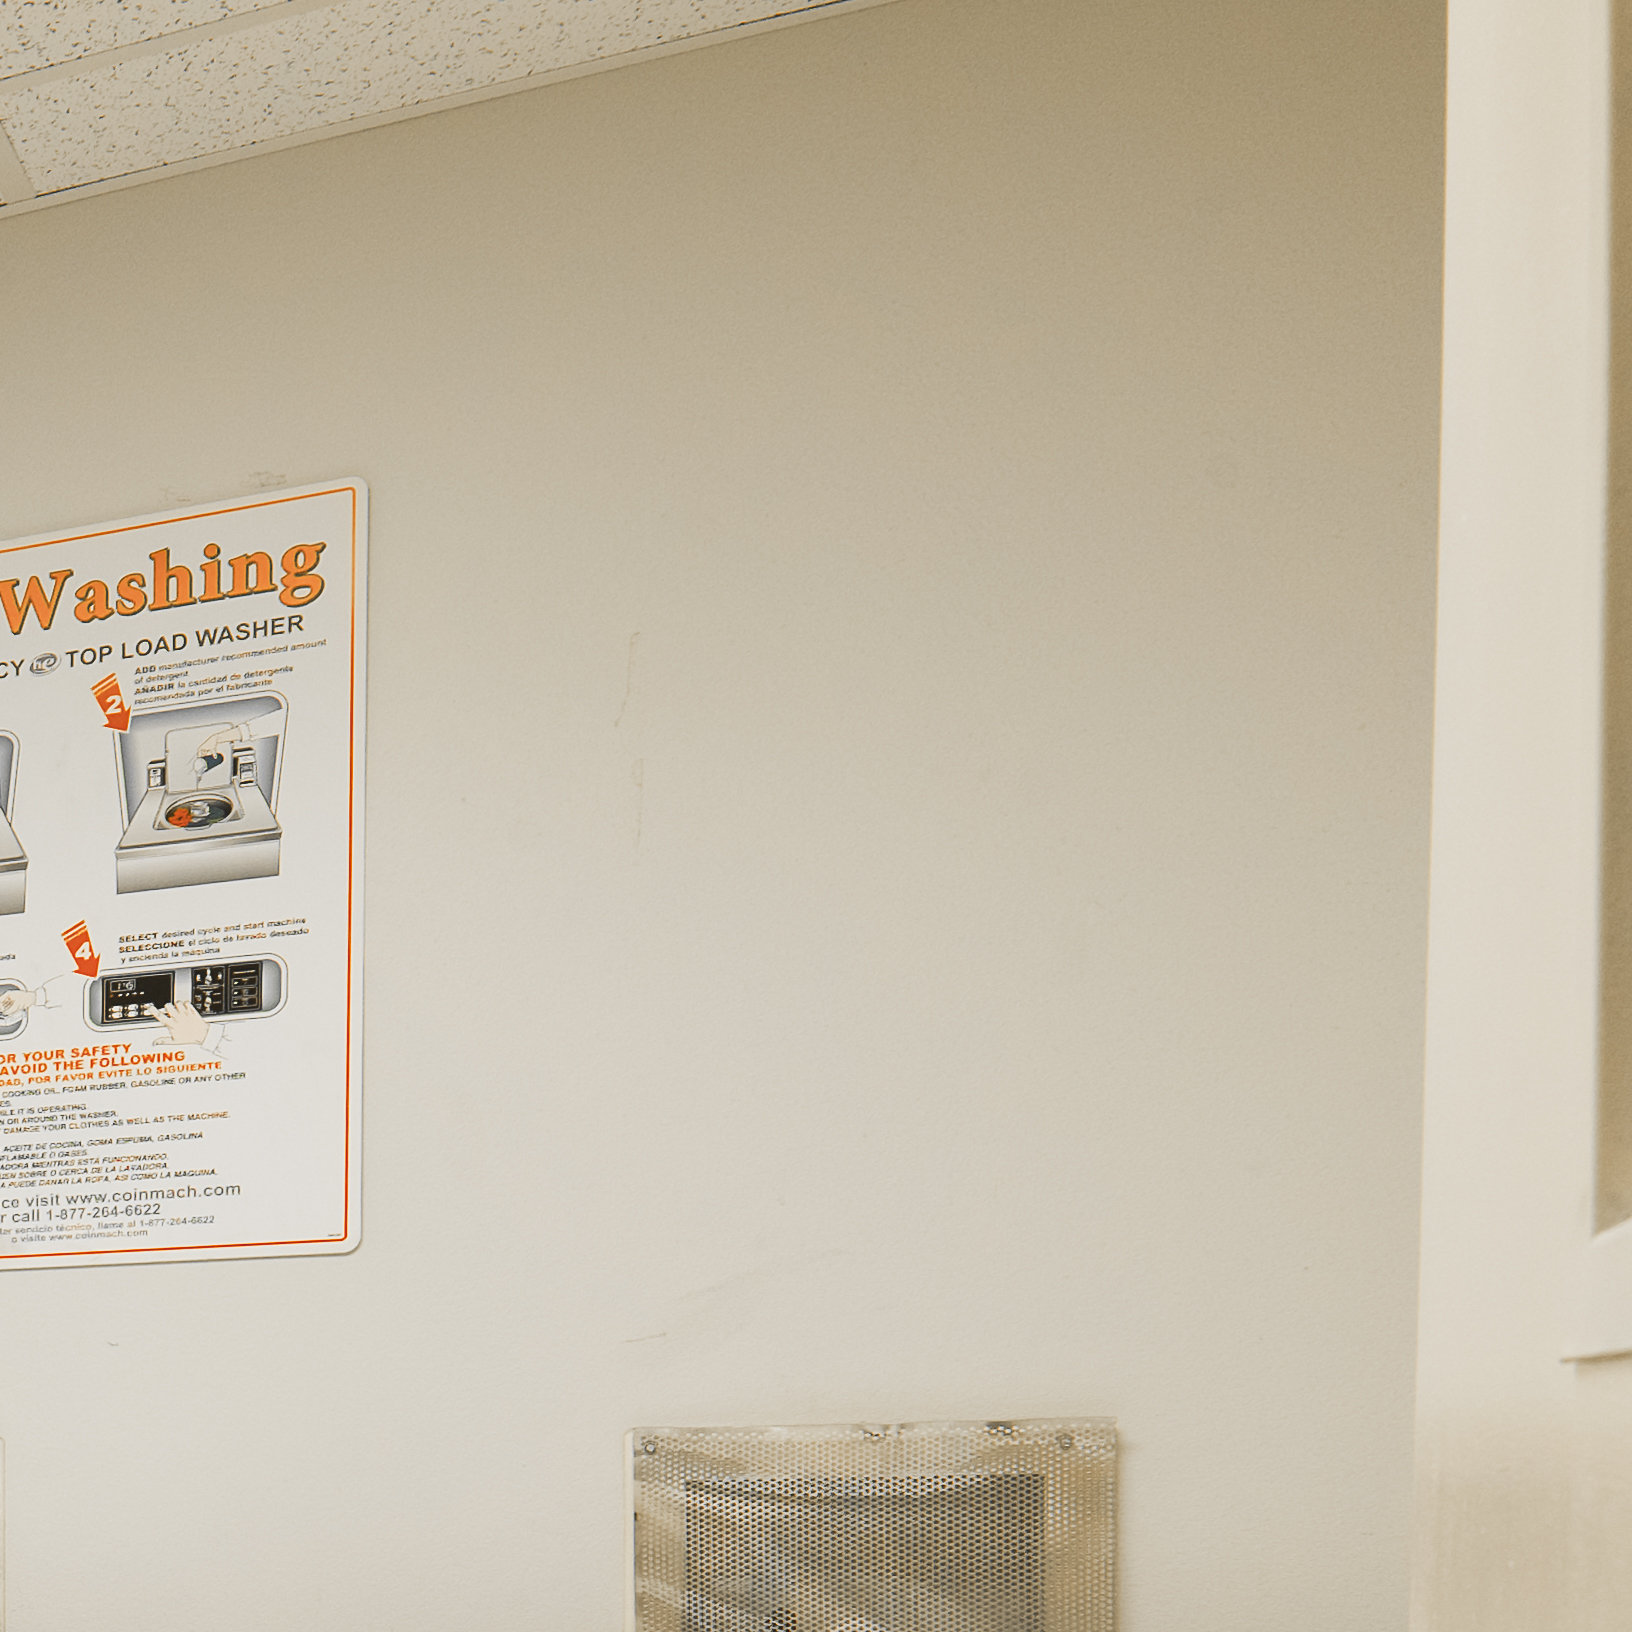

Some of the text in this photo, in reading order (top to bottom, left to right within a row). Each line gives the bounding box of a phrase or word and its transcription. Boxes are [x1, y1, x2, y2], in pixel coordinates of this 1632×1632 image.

[65, 645, 112, 667] TOP
[121, 633, 187, 659] LOAD
[195, 614, 303, 646] WASHER
[134, 665, 156, 674] ADD
[290, 638, 326, 651] amount
[104, 694, 121, 715] 2
[119, 932, 157, 943] SELECT
[74, 941, 90, 961] 4
[0, 1062, 47, 1075] AVOID
[52, 1059, 83, 1071] THE
[90, 1050, 184, 1068] FOLLOWING
[23, 1049, 64, 1062] YOUR
[70, 1043, 131, 1058] SAFETY
[28, 1075, 50, 1084] POR
[55, 1072, 93, 1082] FAVOR
[98, 1068, 132, 1078] EVITE
[136, 1067, 152, 1075] LO
[156, 1061, 221, 1074] SIGUIENTE
[26, 1193, 59, 1207] visit
[65, 1185, 240, 1204] www.coinmach.com
[12, 1208, 39, 1222] call
